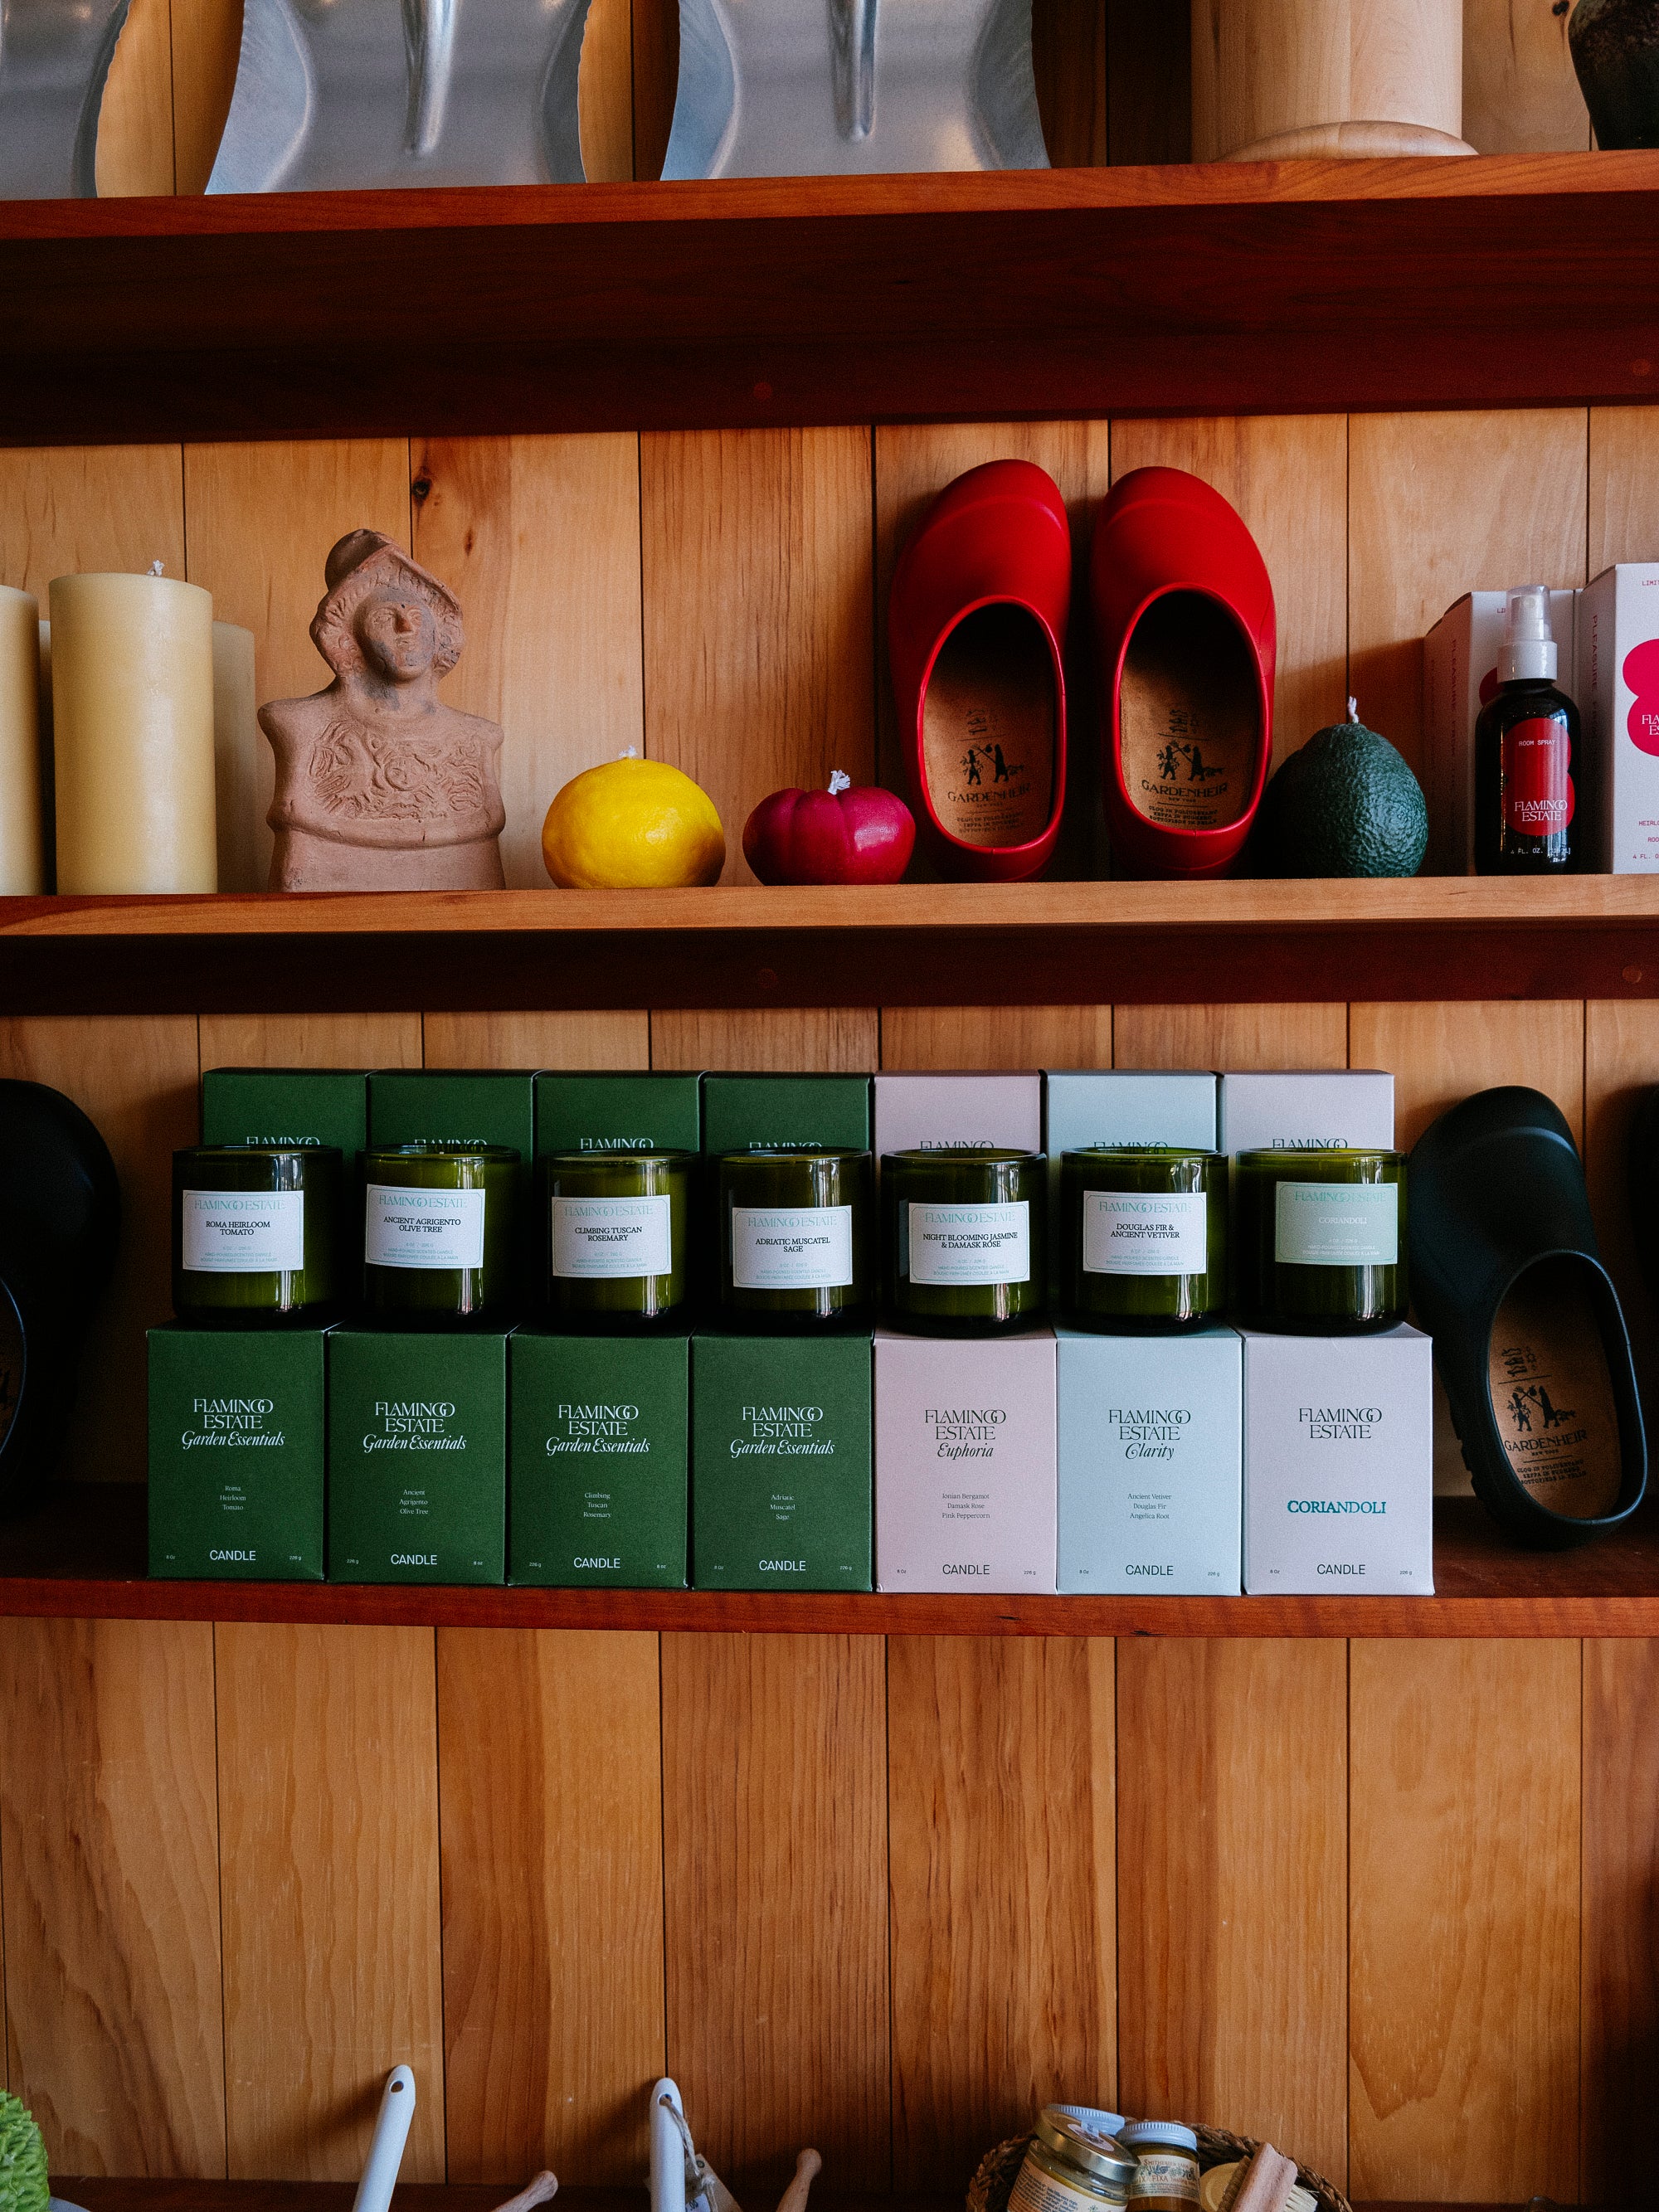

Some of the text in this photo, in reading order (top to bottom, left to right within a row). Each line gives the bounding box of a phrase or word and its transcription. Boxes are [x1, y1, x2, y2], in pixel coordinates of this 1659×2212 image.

[1141, 780, 1228, 797] GARDENHEIR
[1515, 800, 1567, 811] FLAMINGO
[1522, 811, 1561, 822] ESTATE
[581, 1138, 654, 1149] FLAMINGO
[1272, 1139, 1347, 1148] FLAMINGO
[194, 1201, 243, 1210] FLAMINGO
[379, 1195, 468, 1208] FLAMINGO ESTATE
[1099, 1202, 1152, 1213] FLAMINGO
[564, 1206, 653, 1217] FLAMINGO ESTATE
[926, 1212, 1015, 1223] FLAMINGO ESTATE
[748, 1216, 837, 1228] FLAMINGO ESTATE
[194, 1399, 273, 1413] FLAMINGO
[376, 1403, 455, 1417] FLAMINGO
[558, 1405, 639, 1420] FLAMINGO
[204, 1415, 262, 1428] ESTATE
[742, 1407, 823, 1422] FLAMINGO
[925, 1410, 1006, 1424] FLAMINGO
[1109, 1410, 1191, 1424] FLAMINGO
[1299, 1408, 1382, 1422] FLAMINGO
[386, 1418, 444, 1432] ESTATE
[569, 1421, 628, 1435] ESTATE
[753, 1423, 812, 1437] ESTATE
[1310, 1425, 1371, 1439] ESTATE
[182, 1431, 285, 1450] Garden Essentials
[936, 1427, 995, 1440] ESTATE
[1120, 1427, 1180, 1441] ESTATE
[1505, 1429, 1588, 1451] GARDENHEIR
[363, 1434, 467, 1453] Garden Essentials
[547, 1437, 650, 1456] Garden Essentials
[730, 1439, 834, 1458] Garden Essentials
[937, 1442, 994, 1460] Euphoria
[1126, 1442, 1174, 1461] Clarity
[1287, 1500, 1386, 1514] CORIANDOLI
[210, 1550, 255, 1561] CANDLE
[391, 1554, 437, 1565] CANDLE
[574, 1558, 620, 1568] CANDLE
[759, 1560, 805, 1571] CANDLE
[942, 1565, 990, 1575] CANDLE
[1126, 1565, 1173, 1575] CANDLE
[1317, 1564, 1365, 1575] CANDLE
